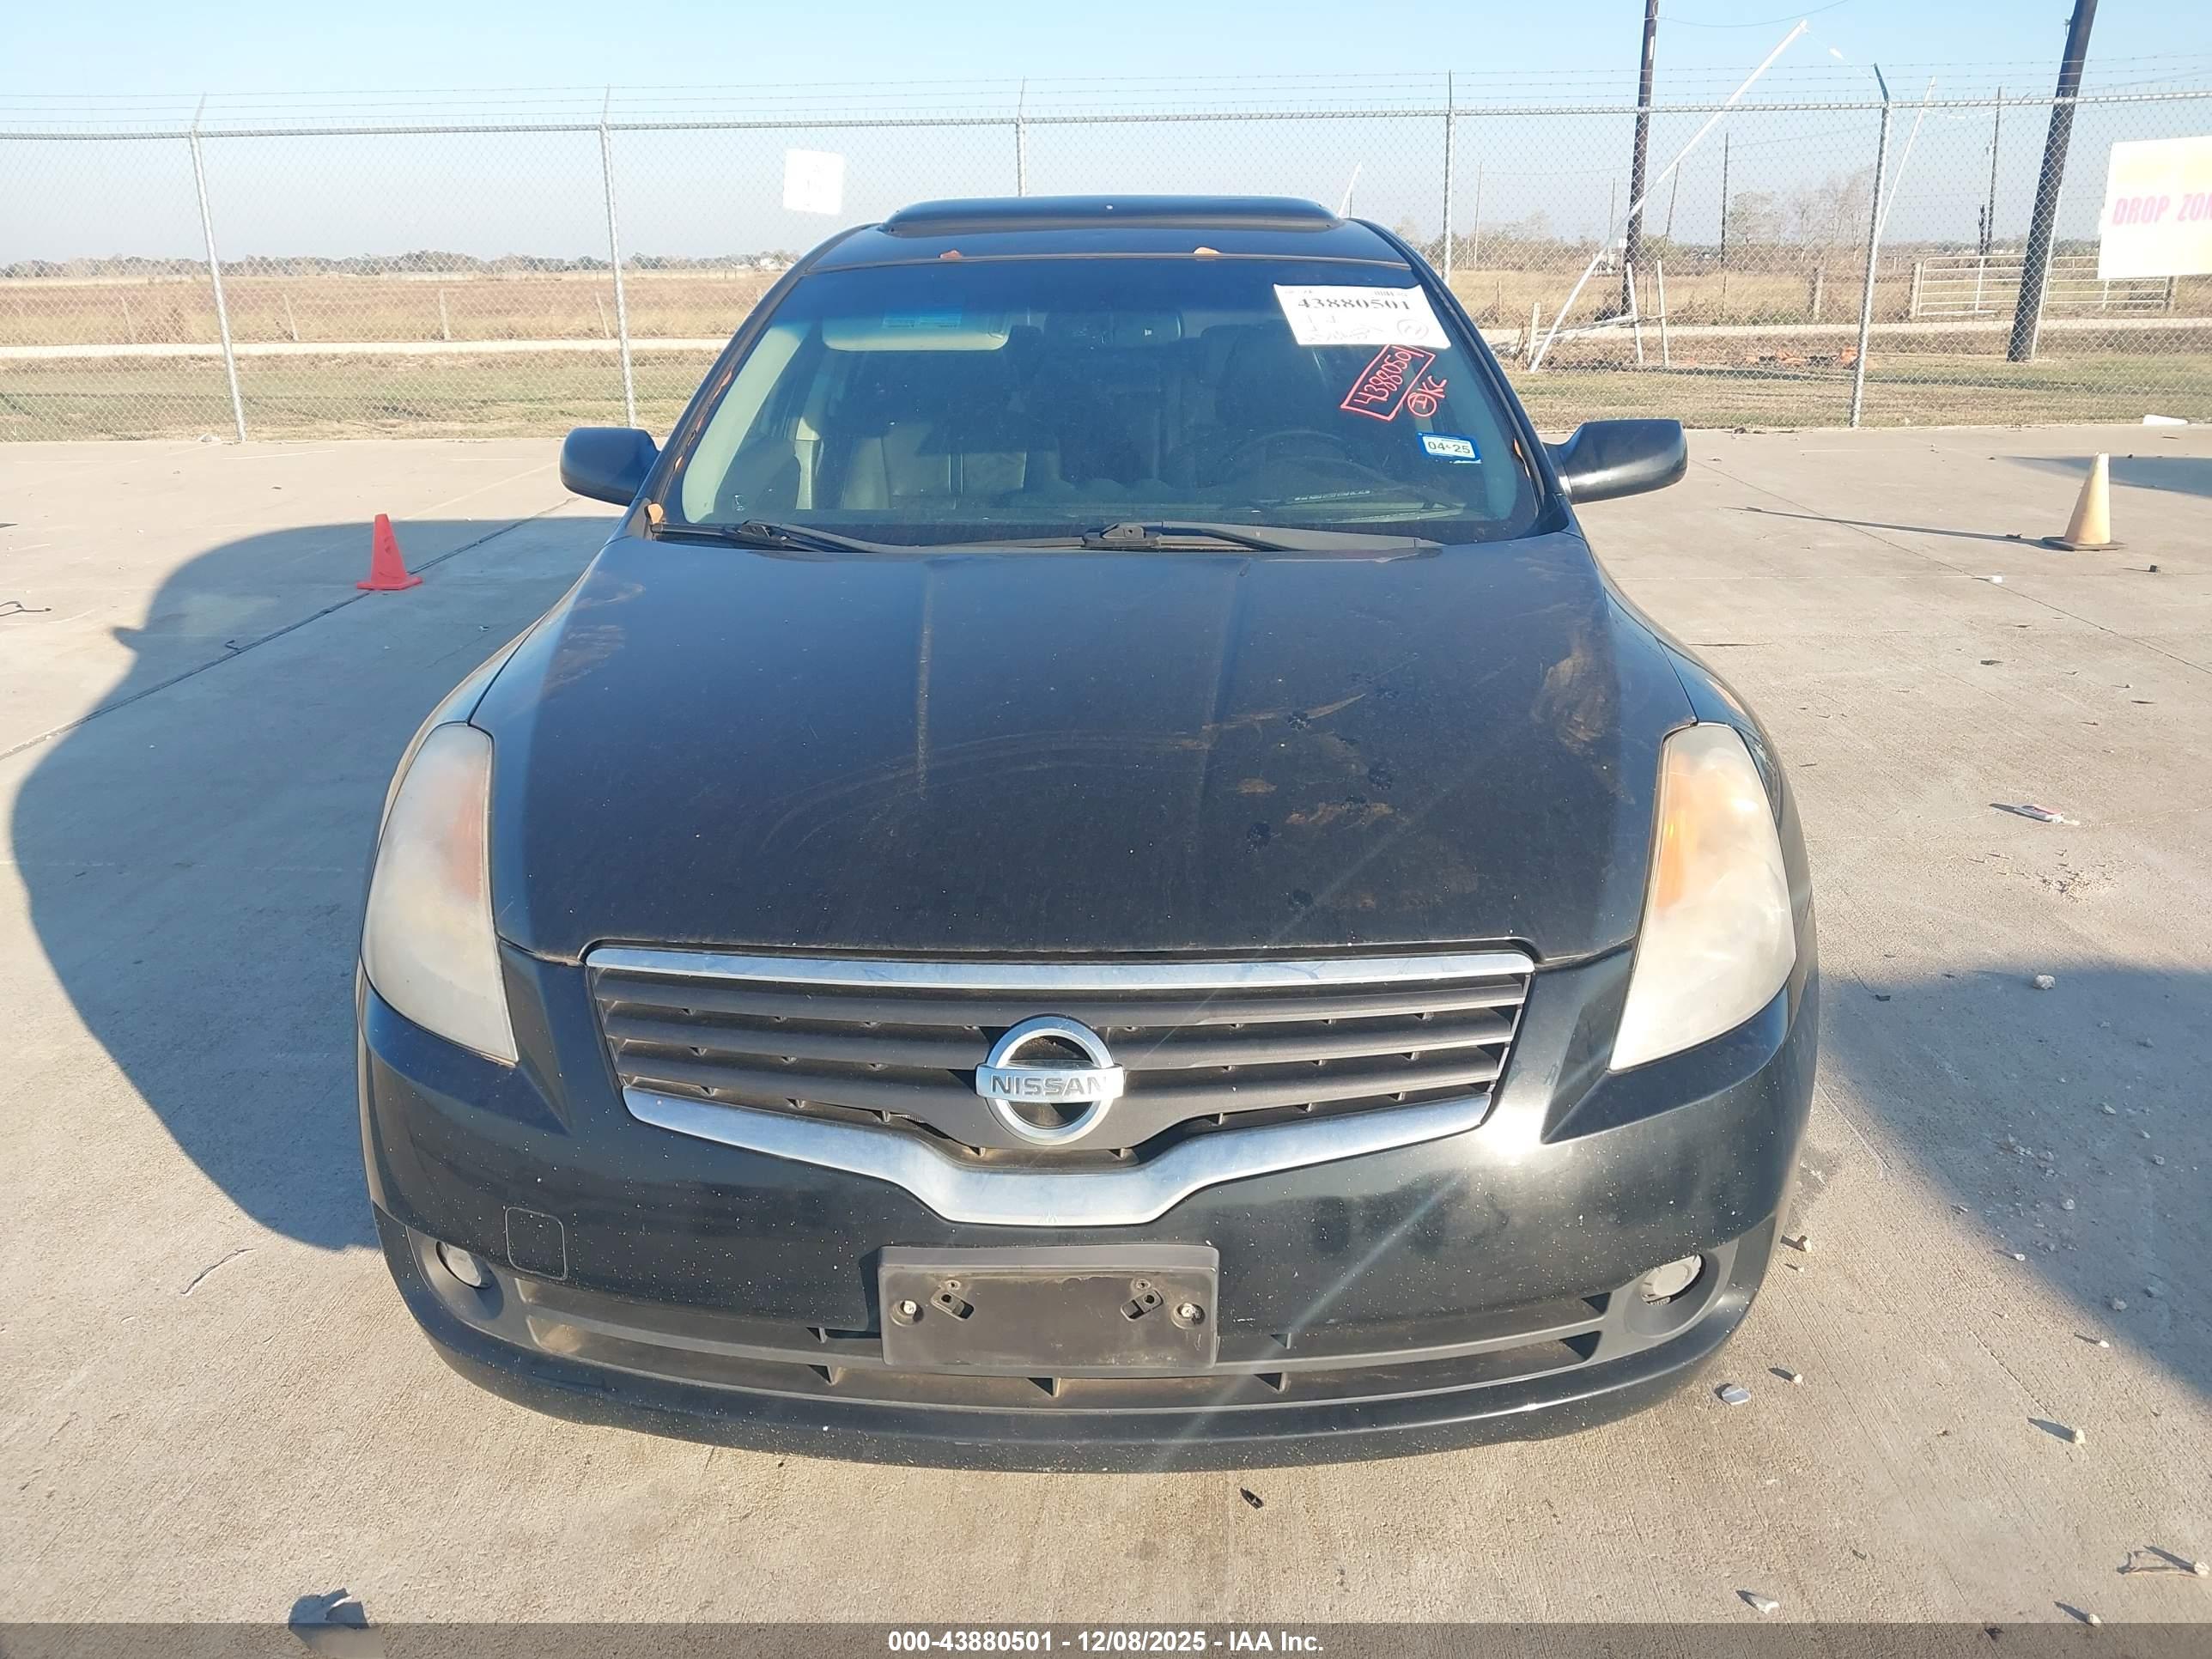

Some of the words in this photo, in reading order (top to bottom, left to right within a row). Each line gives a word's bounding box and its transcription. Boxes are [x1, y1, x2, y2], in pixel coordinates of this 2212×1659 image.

[2112, 197, 2171, 224] DROP
[1297, 298, 1411, 310] 43880501
[1353, 345, 1425, 404] 43880501
[992, 1075, 1106, 1096] NISSAN
